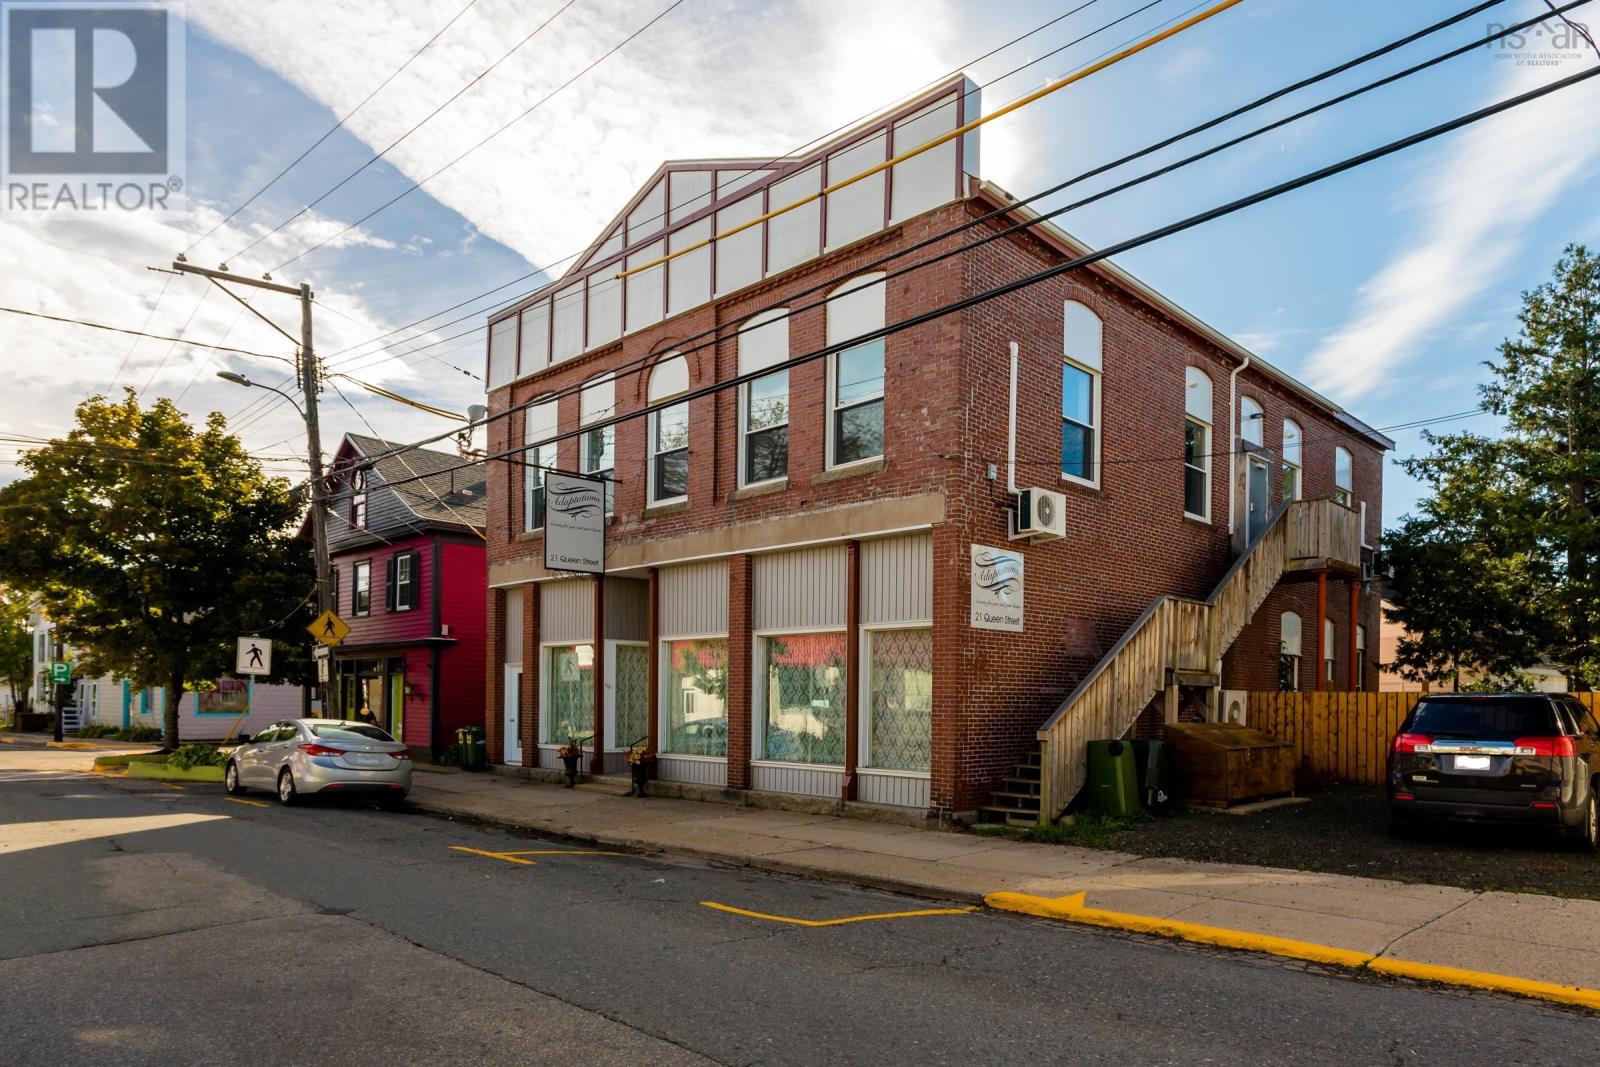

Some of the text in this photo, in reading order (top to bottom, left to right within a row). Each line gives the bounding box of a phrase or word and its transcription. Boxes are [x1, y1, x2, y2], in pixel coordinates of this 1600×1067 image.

[550, 554, 599, 566] 21 Queen Street
[975, 611, 1020, 625] 21 Queen Street
[54, 664, 67, 676] P
